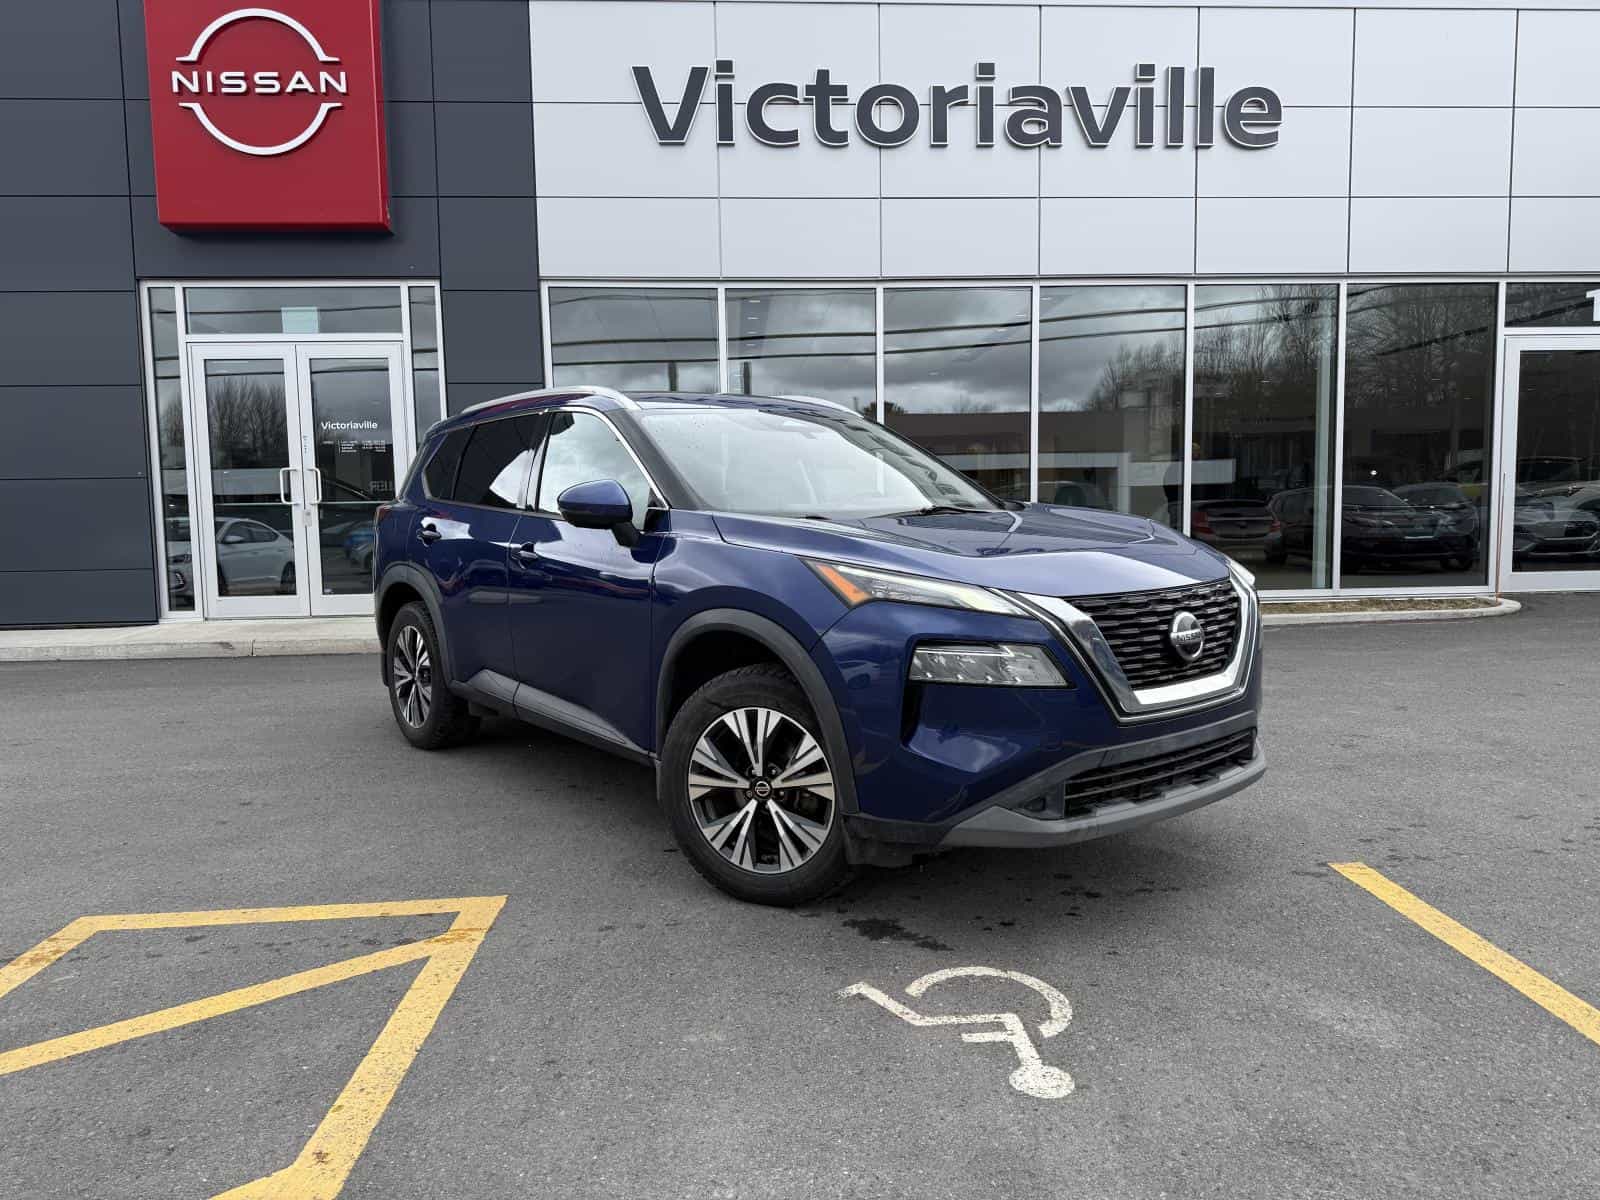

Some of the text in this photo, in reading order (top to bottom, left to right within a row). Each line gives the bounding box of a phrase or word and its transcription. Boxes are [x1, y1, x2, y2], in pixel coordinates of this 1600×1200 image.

[171, 70, 348, 95] NISSAN
[631, 59, 1283, 149] Victoriaville
[320, 420, 379, 430] Victoriaville
